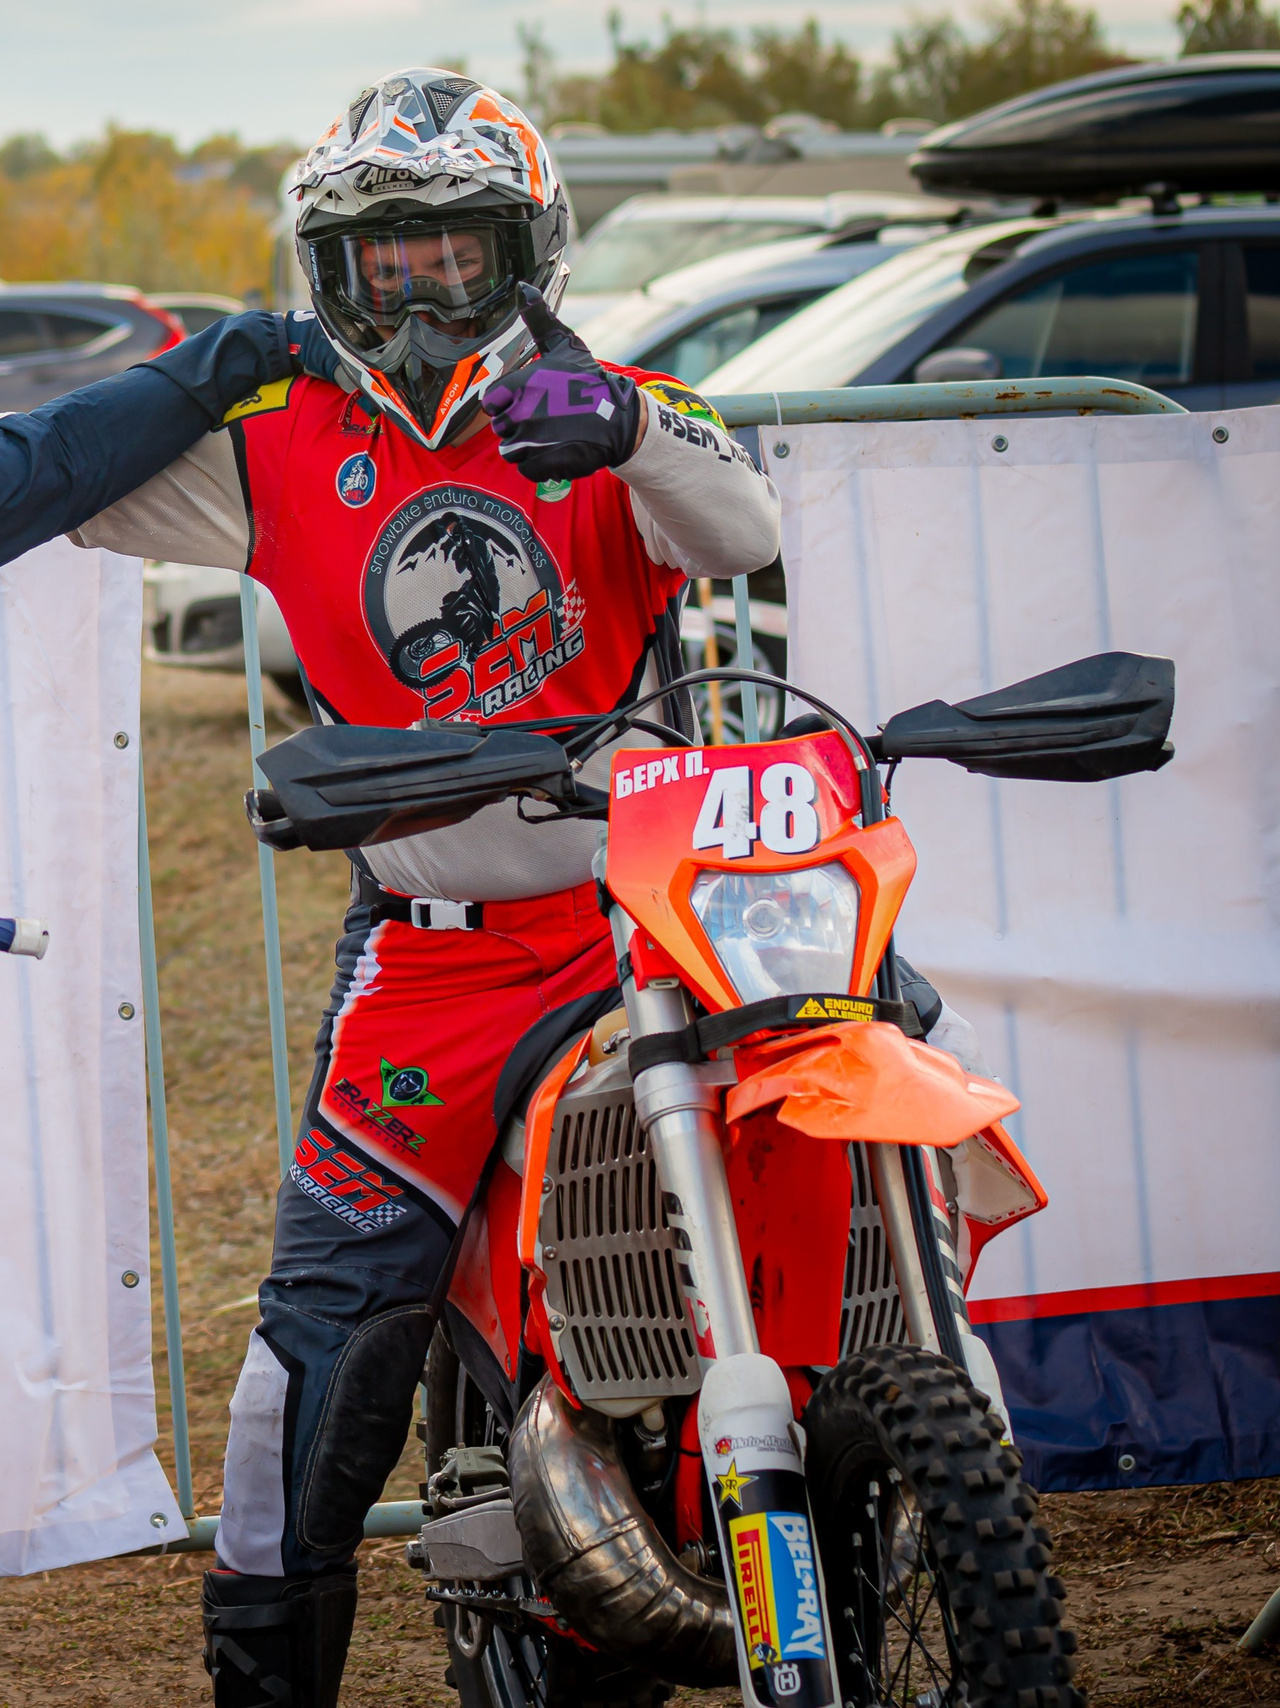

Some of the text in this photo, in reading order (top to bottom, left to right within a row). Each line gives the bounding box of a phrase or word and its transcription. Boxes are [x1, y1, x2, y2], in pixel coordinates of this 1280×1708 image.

[360, 165, 418, 189] Airo
[439, 383, 460, 416] AIROH
[371, 489, 547, 575] snowbike enduro motocross
[420, 588, 555, 721] SEM
[483, 628, 585, 717] RACING
[616, 750, 710, 799] БЕРХ П.
[693, 763, 819, 859] 48
[824, 997, 874, 1015] ENDURO
[828, 1008, 873, 1023] ELEMENT
[335, 1077, 428, 1151] BRAZZERZ
[294, 1128, 405, 1213] SEM
[298, 1175, 380, 1233] RACING
